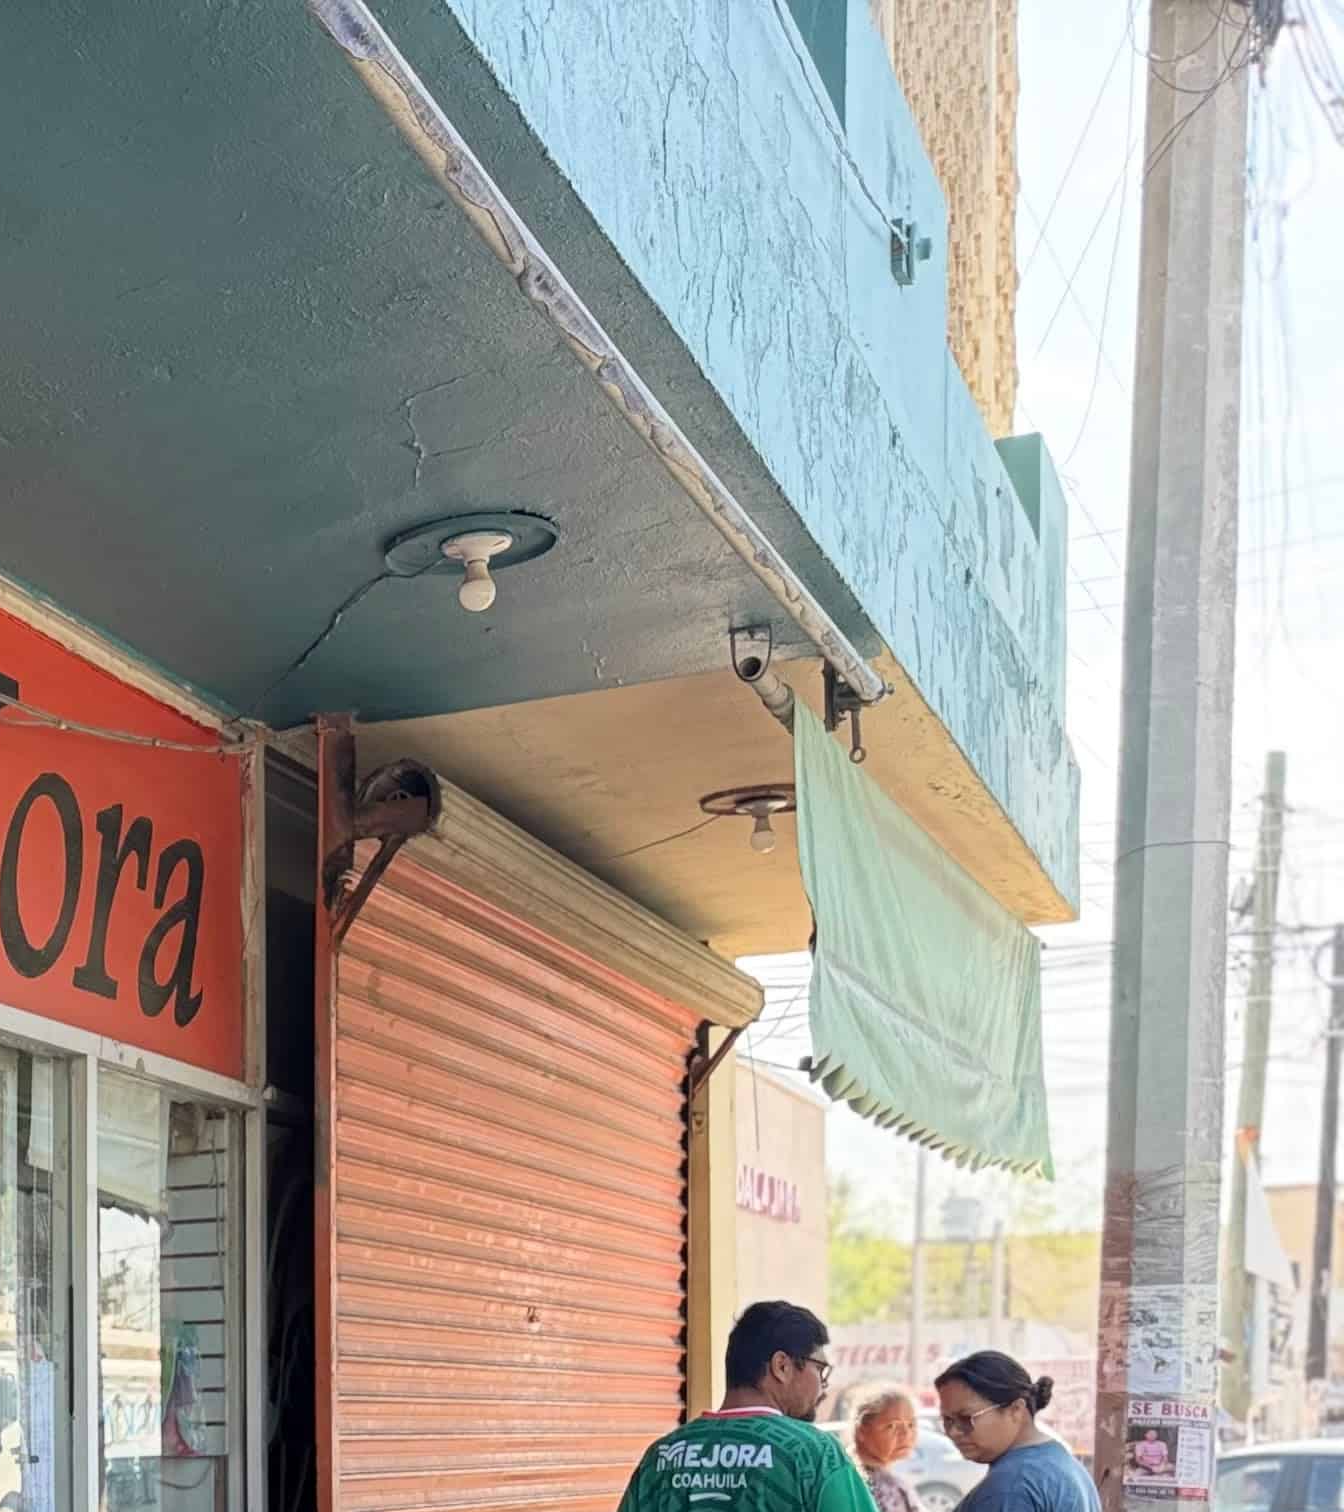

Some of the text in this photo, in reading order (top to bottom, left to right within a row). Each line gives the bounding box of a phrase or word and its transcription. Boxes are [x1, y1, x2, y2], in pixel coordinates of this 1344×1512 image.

[1131, 1402, 1209, 1418] SE BUSCA
[656, 1439, 773, 1472] MEJORA
[671, 1472, 748, 1489] COAHUILA
